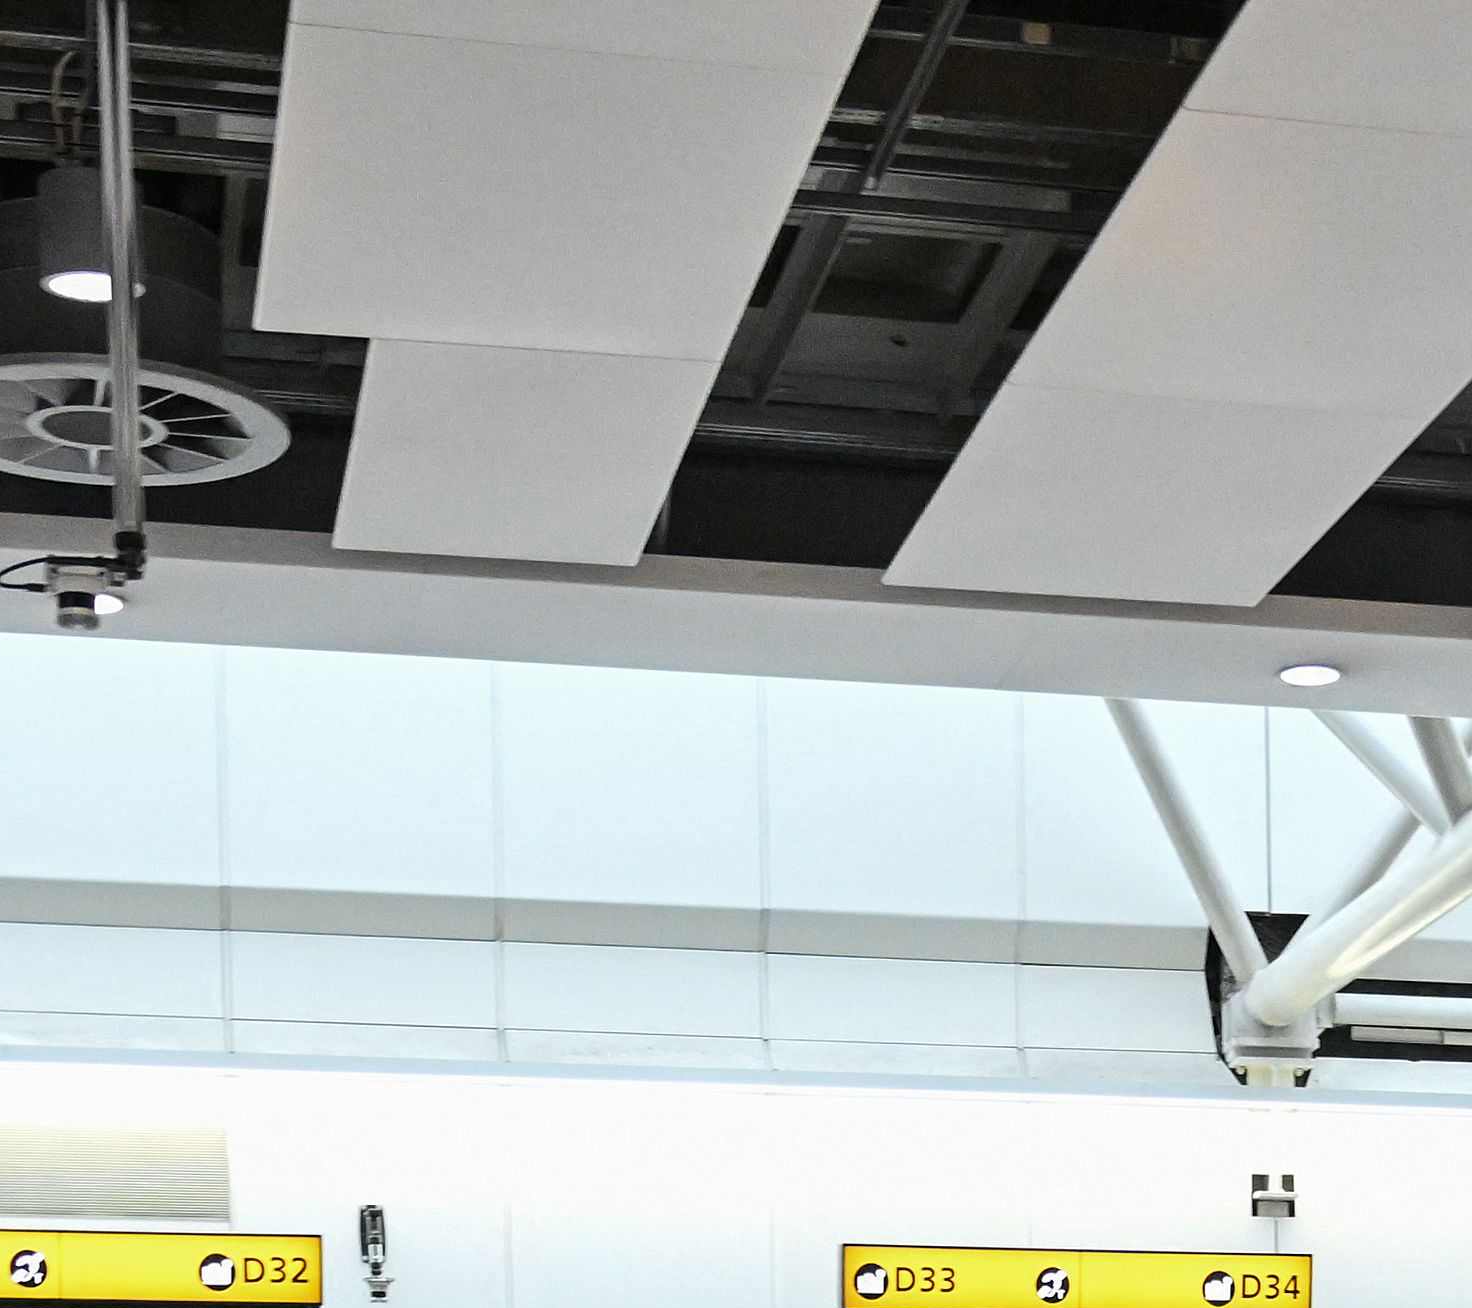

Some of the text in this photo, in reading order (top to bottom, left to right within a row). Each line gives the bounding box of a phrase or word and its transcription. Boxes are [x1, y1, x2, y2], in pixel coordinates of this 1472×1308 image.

[243, 1257, 309, 1284] D32
[896, 1266, 1301, 1300] D33 D34
